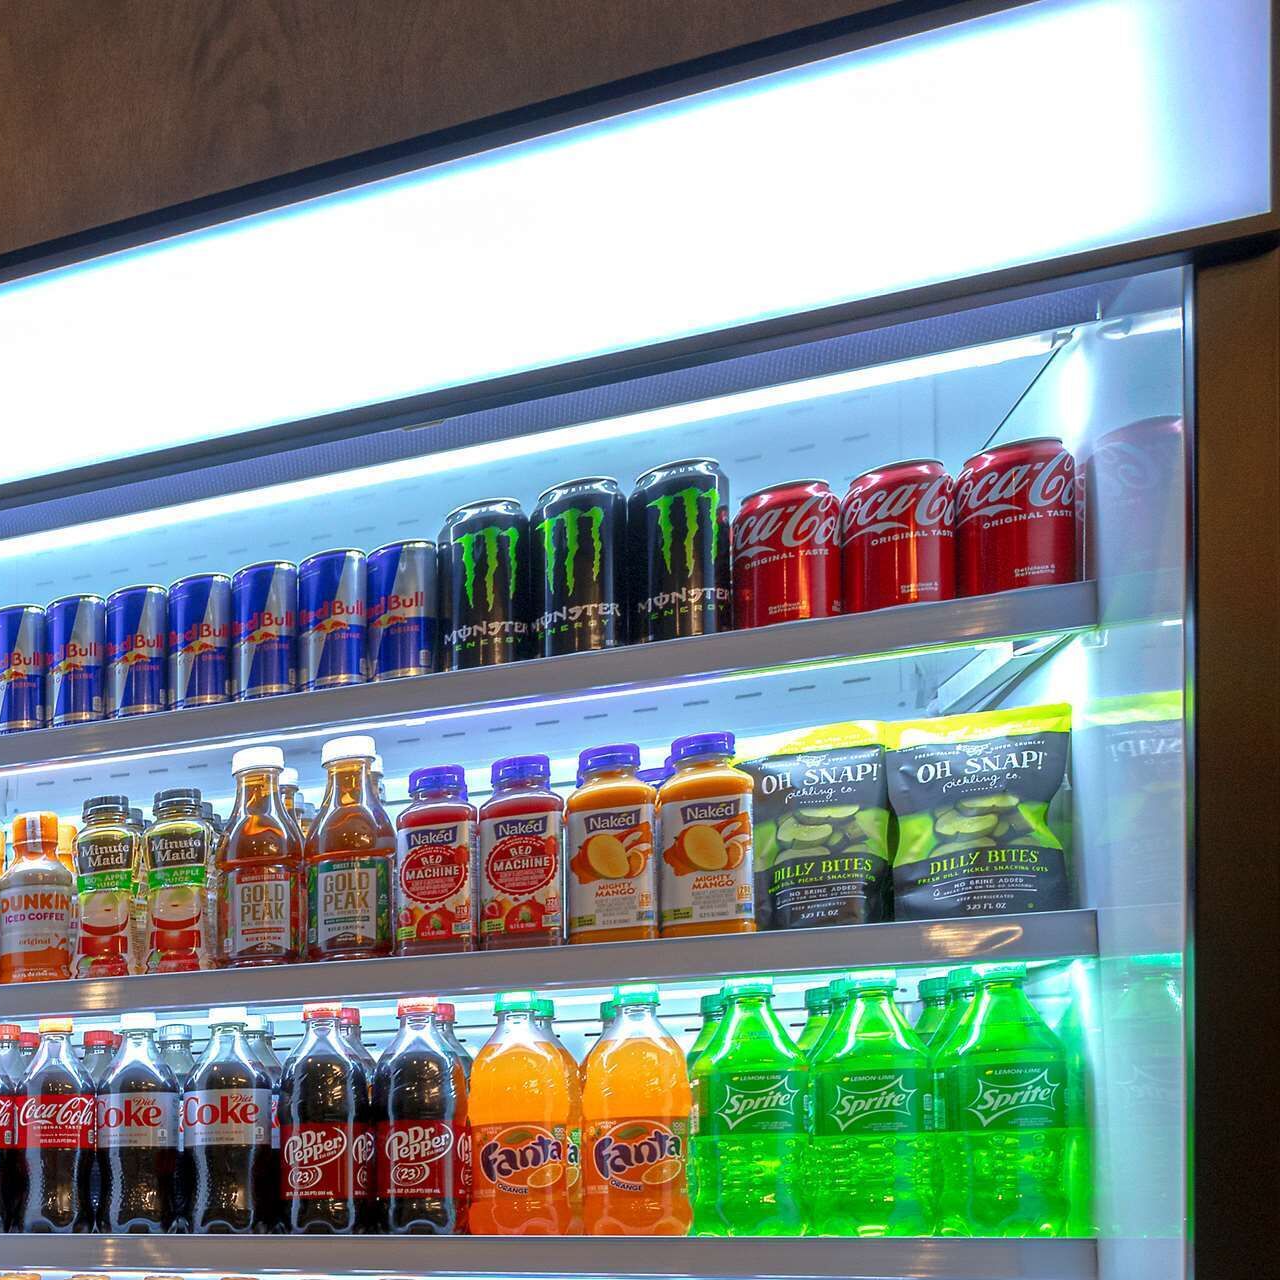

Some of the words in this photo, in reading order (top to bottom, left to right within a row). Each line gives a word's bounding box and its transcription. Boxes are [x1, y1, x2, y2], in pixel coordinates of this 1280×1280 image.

[982, 511, 1042, 529] ORIGINAL
[332, 600, 363, 615] Bull
[388, 592, 424, 610] Bull
[638, 587, 730, 613] MONSTER
[262, 612, 293, 627] Bull
[531, 602, 621, 633] MONSTER
[134, 634, 163, 648] Bull
[444, 620, 528, 646] MONSTER
[67, 642, 96, 657] Bull
[916, 764, 952, 785] OH
[963, 750, 1044, 775] SNAP!
[761, 774, 791, 795] OH
[803, 763, 878, 786] SNAP!
[942, 773, 1001, 792] pickling
[786, 786, 836, 804] pickling
[686, 803, 735, 821] Naked
[498, 818, 544, 835] Naked
[589, 813, 636, 830] Naked
[151, 837, 201, 852] Minute
[410, 828, 453, 846] Naked
[82, 841, 129, 858] Minute
[156, 849, 196, 862] Maid
[510, 845, 532, 856] RED
[88, 853, 124, 868] Maid
[421, 856, 442, 866] RED
[493, 857, 550, 871] MACHINE
[929, 853, 978, 875] DILLY
[988, 849, 1039, 863] BITES
[405, 866, 459, 881] MACHINE
[695, 874, 732, 884] MIGHTY
[774, 861, 816, 882] DILLY
[822, 858, 872, 873] BITES
[960, 868, 987, 876] PICKLE
[989, 865, 1029, 873] SNACKING
[323, 872, 369, 892] GOLD
[598, 882, 633, 891] MIGHTY
[691, 880, 735, 890] MANGO
[954, 882, 967, 890] NO
[970, 880, 995, 888] BRINE
[998, 877, 1024, 885] ADDED
[240, 883, 284, 901] GOLD
[595, 887, 636, 897] MANGO
[323, 893, 369, 912] PEAK
[5, 914, 26, 924] ICED
[28, 912, 65, 922] COFFEE
[241, 903, 285, 922] PEAK
[724, 1088, 792, 1119] Sprite
[837, 1087, 906, 1118] Sprite
[980, 1085, 1052, 1114] Sprite
[96, 1098, 162, 1129] Coke
[184, 1096, 259, 1128] Coke
[302, 1131, 326, 1143] Dr
[408, 1126, 434, 1140] Dr
[289, 1136, 342, 1165] Pepper
[390, 1131, 449, 1161] Pepper
[594, 1130, 681, 1179] Fanta
[480, 1135, 562, 1183] Fanta
[401, 1168, 415, 1179] 23
[497, 1183, 528, 1194] ORANGE
